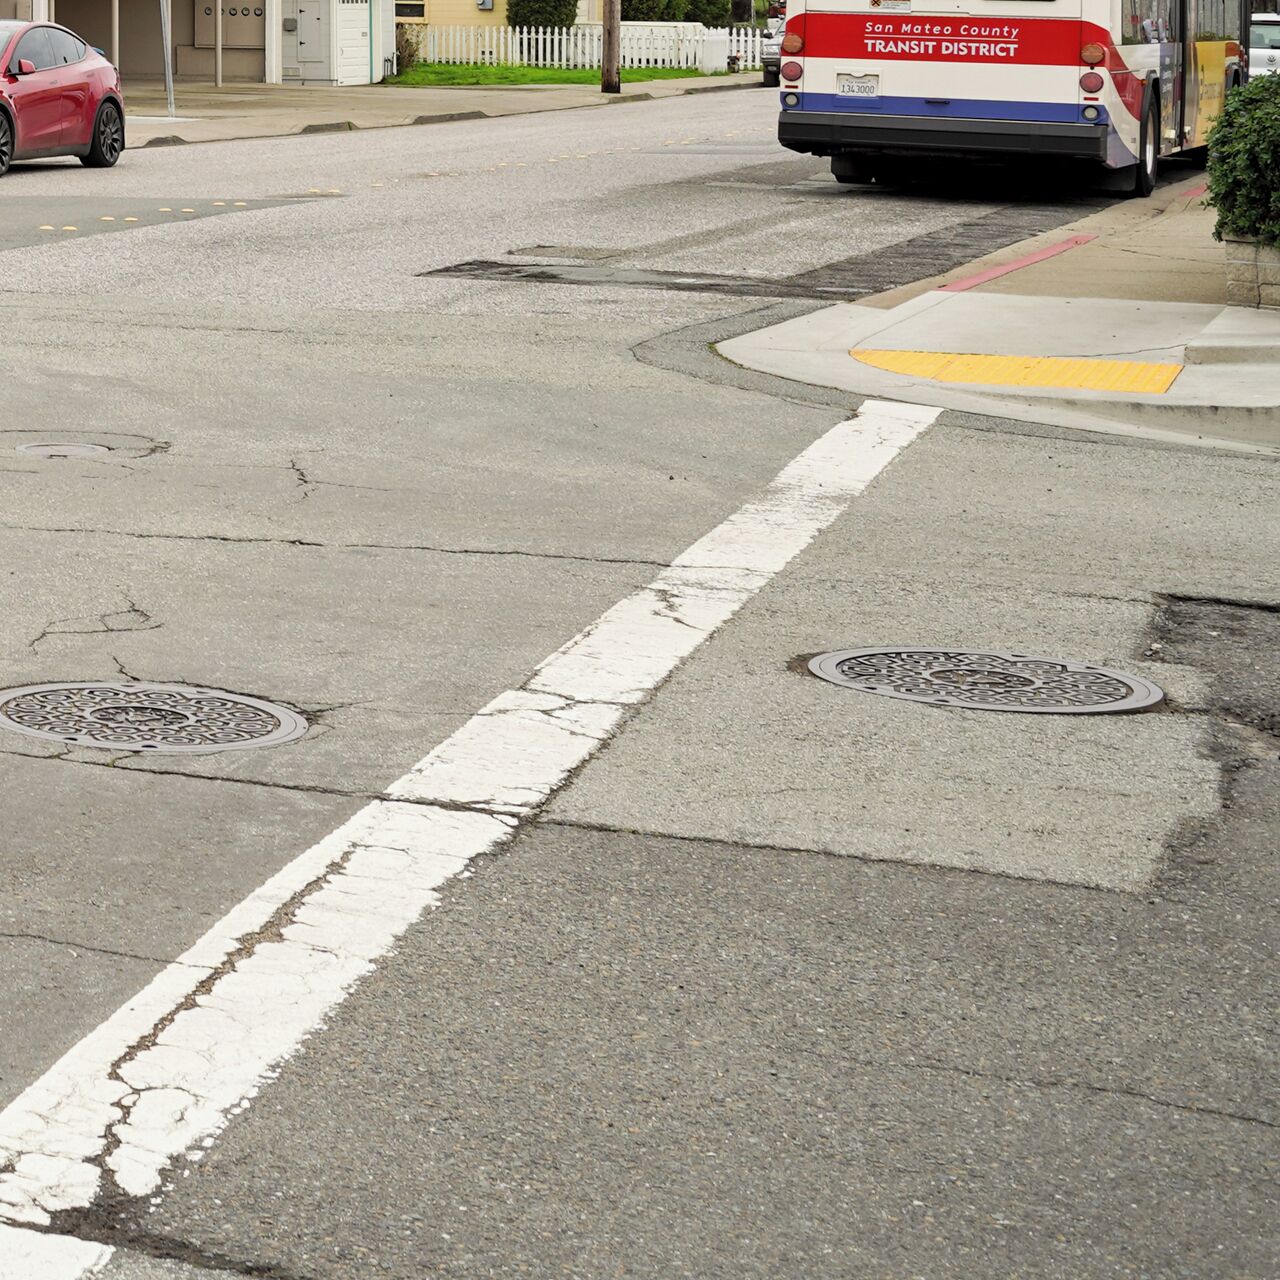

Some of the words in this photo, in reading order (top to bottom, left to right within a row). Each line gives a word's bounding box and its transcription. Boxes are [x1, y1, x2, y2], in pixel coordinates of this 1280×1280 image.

[864, 21, 894, 33] San
[901, 23, 952, 35] Mateo
[960, 24, 1019, 39] County
[864, 39, 937, 55] TRANSIT
[941, 41, 1019, 57] DISTRICT
[841, 84, 875, 95] 1343000
